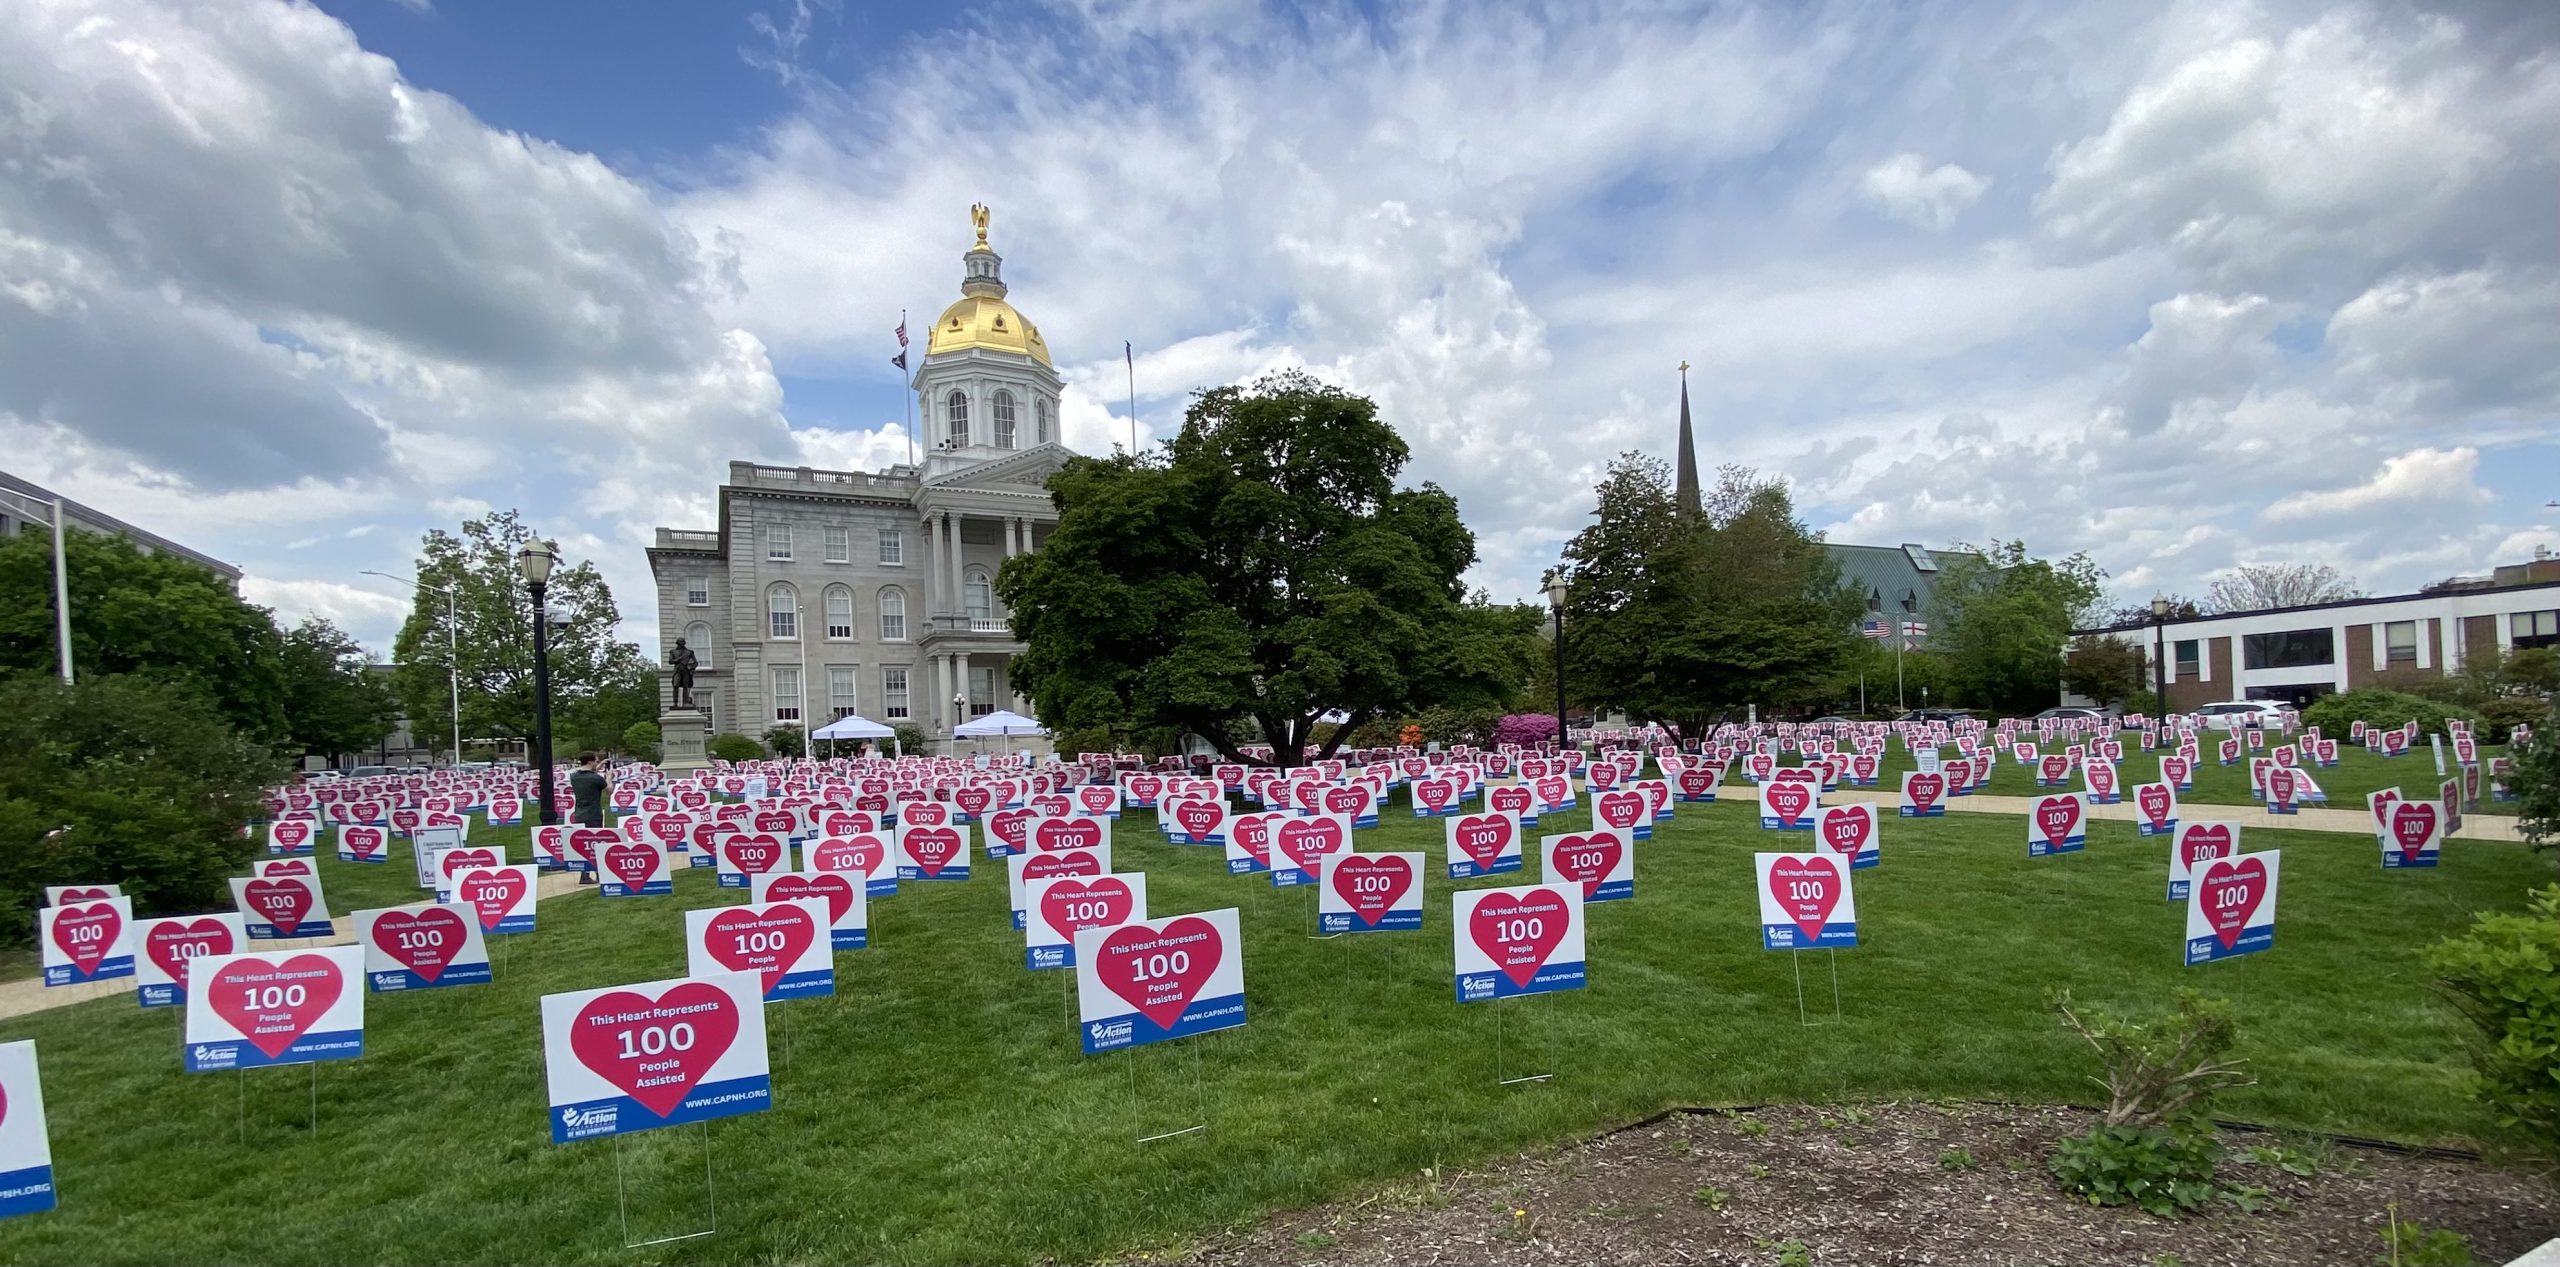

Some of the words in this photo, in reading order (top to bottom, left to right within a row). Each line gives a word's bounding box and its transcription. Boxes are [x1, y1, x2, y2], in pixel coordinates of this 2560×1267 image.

[1859, 763, 1870, 771] 100
[1950, 771, 1963, 779] 100
[2095, 775, 2108, 784] 100
[1687, 778, 1704, 786] 100
[1426, 790, 1444, 798] 100
[1544, 786, 1559, 795] 100
[1916, 785, 1934, 795] 100
[865, 802, 881, 810] 100
[1338, 798, 1358, 809] 100
[1502, 799, 1521, 808] 100
[1777, 796, 1799, 807] 100
[2148, 798, 2163, 810] 100
[1611, 805, 1633, 817] 100
[915, 813, 935, 822] 100
[1188, 813, 1210, 823] 100
[2048, 812, 2068, 825] 100
[660, 824, 681, 832] 100
[766, 821, 786, 830] 100
[838, 825, 860, 834] 100
[1004, 821, 1026, 833] 100
[2403, 821, 2424, 834] 100
[282, 830, 299, 838] 100
[1471, 831, 1497, 845] 100
[1835, 824, 1859, 840] 100
[354, 837, 372, 845] 100
[848, 843, 875, 851] Represents
[1054, 835, 1083, 847] 100
[1295, 835, 1326, 851] 100
[919, 842, 945, 853] 100
[2193, 845, 2217, 860] 100
[739, 849, 766, 860] 100
[1570, 852, 1603, 869] 100
[619, 858, 645, 869] 100
[832, 854, 865, 869] 100
[1061, 861, 1091, 869] Represents
[1354, 876, 1390, 893] 100
[1790, 881, 1824, 900] 100
[477, 887, 508, 901] 100
[1066, 891, 1085, 899] Heart
[1087, 889, 1122, 898] Represents
[2216, 885, 2248, 909] 100
[263, 896, 295, 909] 100
[1519, 904, 1558, 913] Represents
[1066, 901, 1108, 921] 100
[416, 919, 454, 927] Represents
[735, 922, 756, 930] Heart
[759, 917, 801, 927] Represents
[70, 925, 103, 944] 100
[1497, 918, 1543, 943] 100
[399, 930, 443, 949] 100
[735, 931, 785, 955] 100
[1110, 945, 1129, 955] This
[1131, 941, 1156, 952] Heart
[1158, 932, 1207, 948] Represents
[169, 942, 209, 961] 100
[414, 950, 437, 958] People
[1509, 945, 1533, 953] People
[413, 958, 441, 966] Assisted
[749, 955, 775, 964] People
[1507, 956, 1535, 965] Assisted
[1132, 951, 1190, 982] 100
[247, 974, 273, 982] Heart
[275, 970, 328, 980] Represents
[778, 979, 832, 990] WWW.CAPNH.ORG
[1148, 981, 1178, 993] People
[1470, 980, 1494, 990] Action
[244, 984, 306, 1011] 100
[1146, 993, 1182, 1006] Assisted
[259, 1013, 292, 1022] People
[590, 1015, 614, 1026] This
[617, 1010, 650, 1023] Heart
[654, 1002, 719, 1018] Represents
[1183, 1005, 1243, 1022] WWW.CAPNH.ORG
[255, 1024, 295, 1034] Assisted
[1101, 1026, 1132, 1038] Action
[292, 1041, 359, 1052] WWW.CAPNH.ORG
[618, 1023, 695, 1060] 100
[639, 1059, 680, 1073] People
[636, 1073, 685, 1088] Assisted
[686, 1090, 767, 1108] WWW.CAPNH.ORG
[575, 1111, 616, 1126] Action
[0, 1183, 50, 1199] NH.ORG
